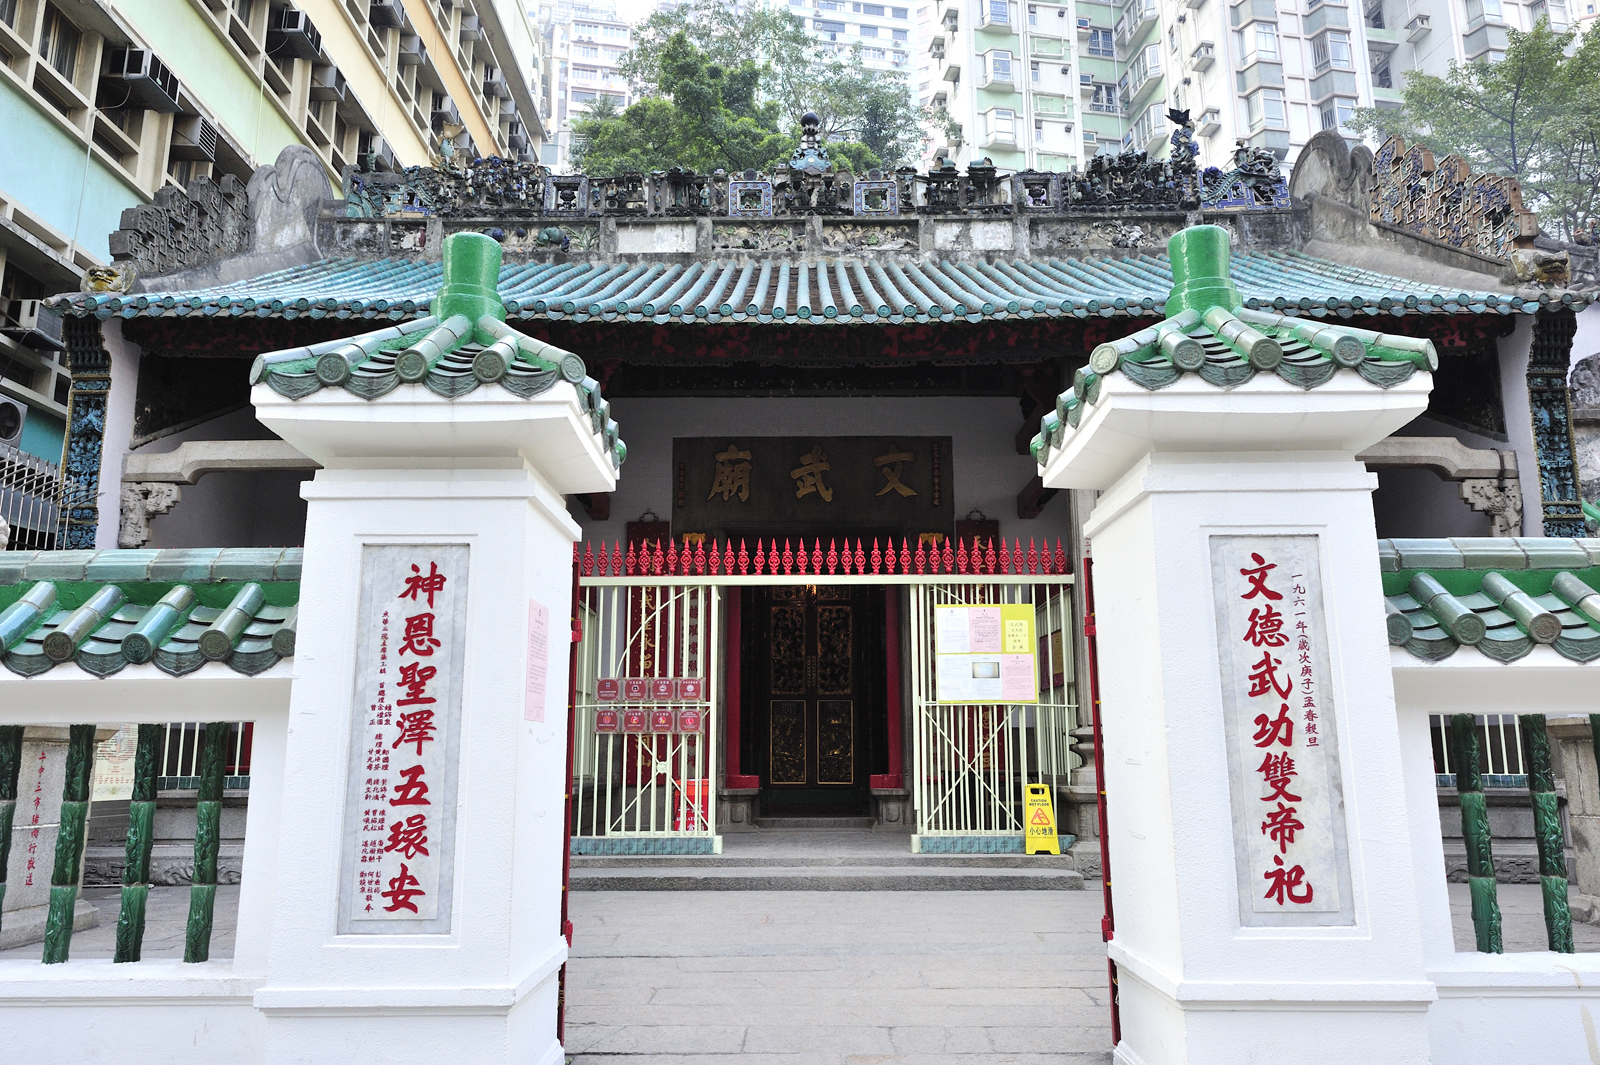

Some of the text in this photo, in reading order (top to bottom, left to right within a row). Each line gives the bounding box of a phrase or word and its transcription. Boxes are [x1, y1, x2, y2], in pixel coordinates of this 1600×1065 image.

[382, 561, 447, 914] 神恩聖澤五環安
[1029, 826, 1054, 836] 小心地滑
[1240, 553, 1313, 905] 文德武功雙帝祀
